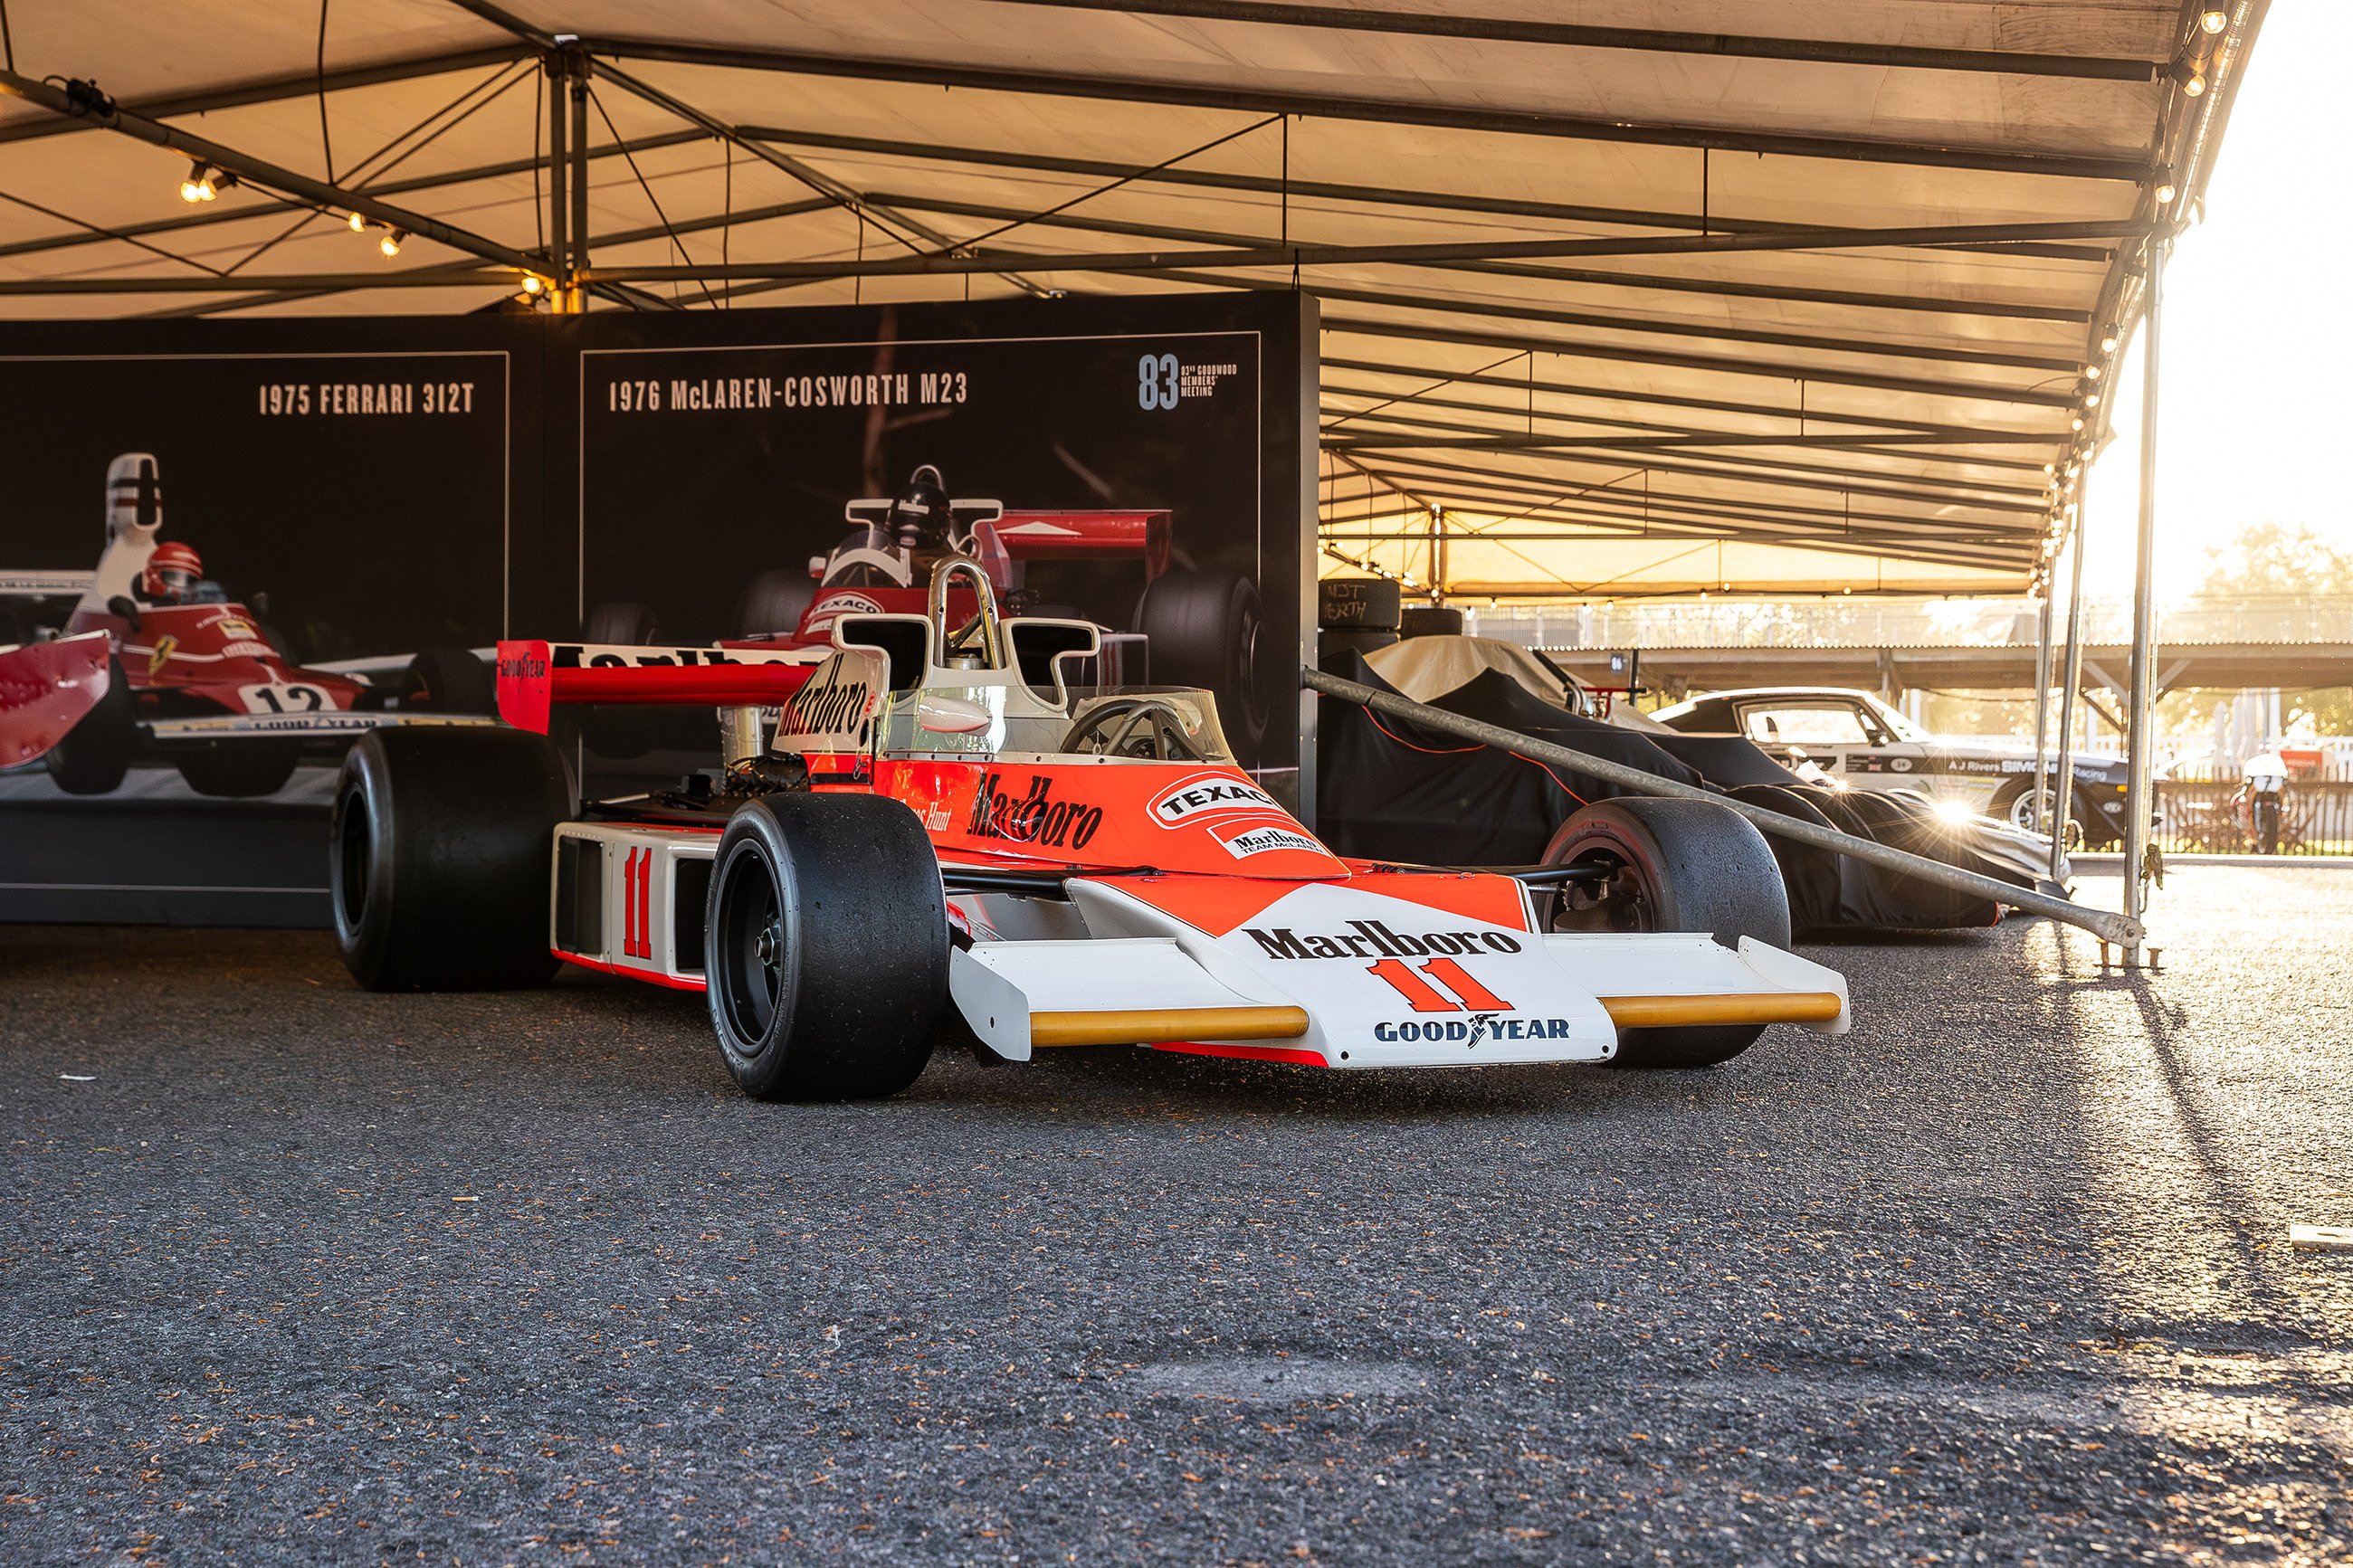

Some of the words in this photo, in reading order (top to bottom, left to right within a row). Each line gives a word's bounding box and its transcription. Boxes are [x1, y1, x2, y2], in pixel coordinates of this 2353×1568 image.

[1138, 354, 1178, 410] 83
[1197, 364, 1237, 375] GOODWOOD
[260, 385, 310, 415] 1975
[319, 384, 413, 414] FERRARI
[423, 383, 474, 413] 312T
[609, 381, 661, 412] 1976
[671, 374, 909, 410] McLAREN-COSWORTH
[920, 373, 967, 404] M23
[1180, 386, 1213, 397] MEETING
[926, 801, 952, 832] Hunt
[967, 773, 1102, 851] Marlboro
[1161, 785, 1274, 816] TEXAC
[1233, 830, 1316, 850] Marlboro
[1241, 843, 1273, 854] TEAM
[624, 846, 652, 960] 11
[1242, 920, 1522, 960] Marlboro
[1365, 957, 1516, 1012] 11
